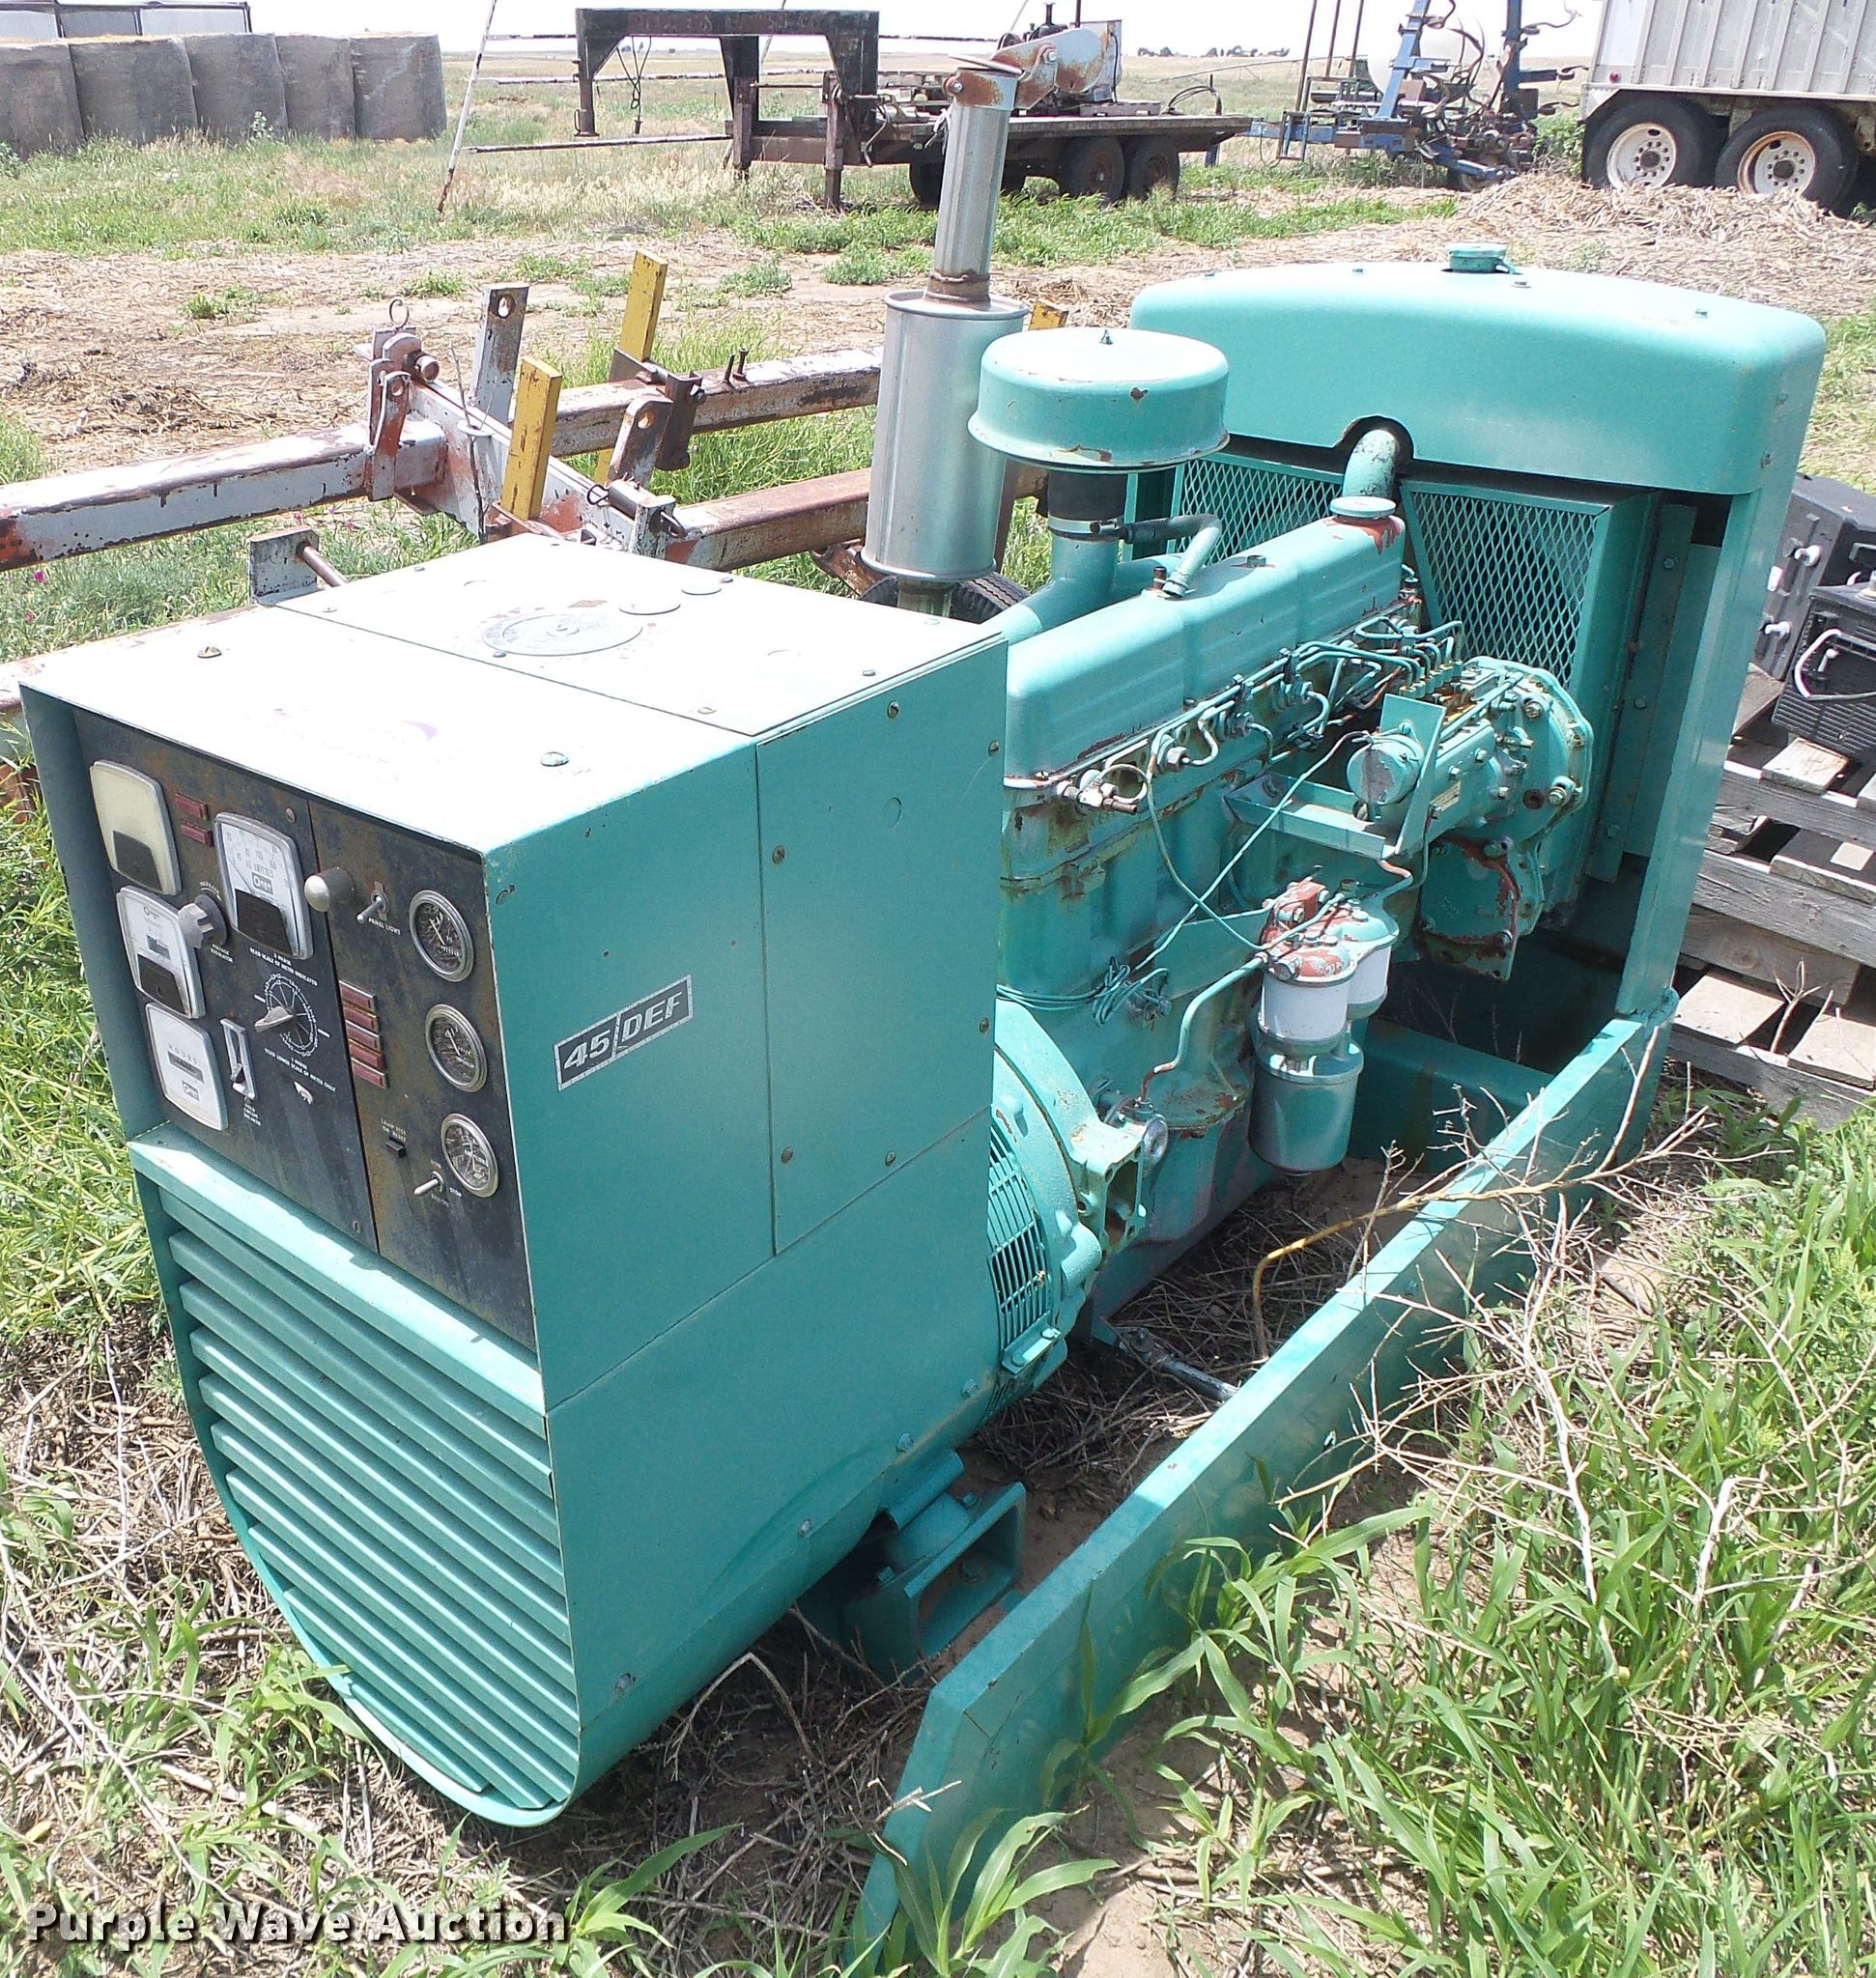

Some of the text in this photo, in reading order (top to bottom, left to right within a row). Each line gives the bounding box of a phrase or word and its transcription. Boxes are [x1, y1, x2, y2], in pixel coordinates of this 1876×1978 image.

[368, 918, 384, 929] PANEL
[564, 992, 683, 1069] 45 DEF
[449, 1187, 463, 1198] STOP
